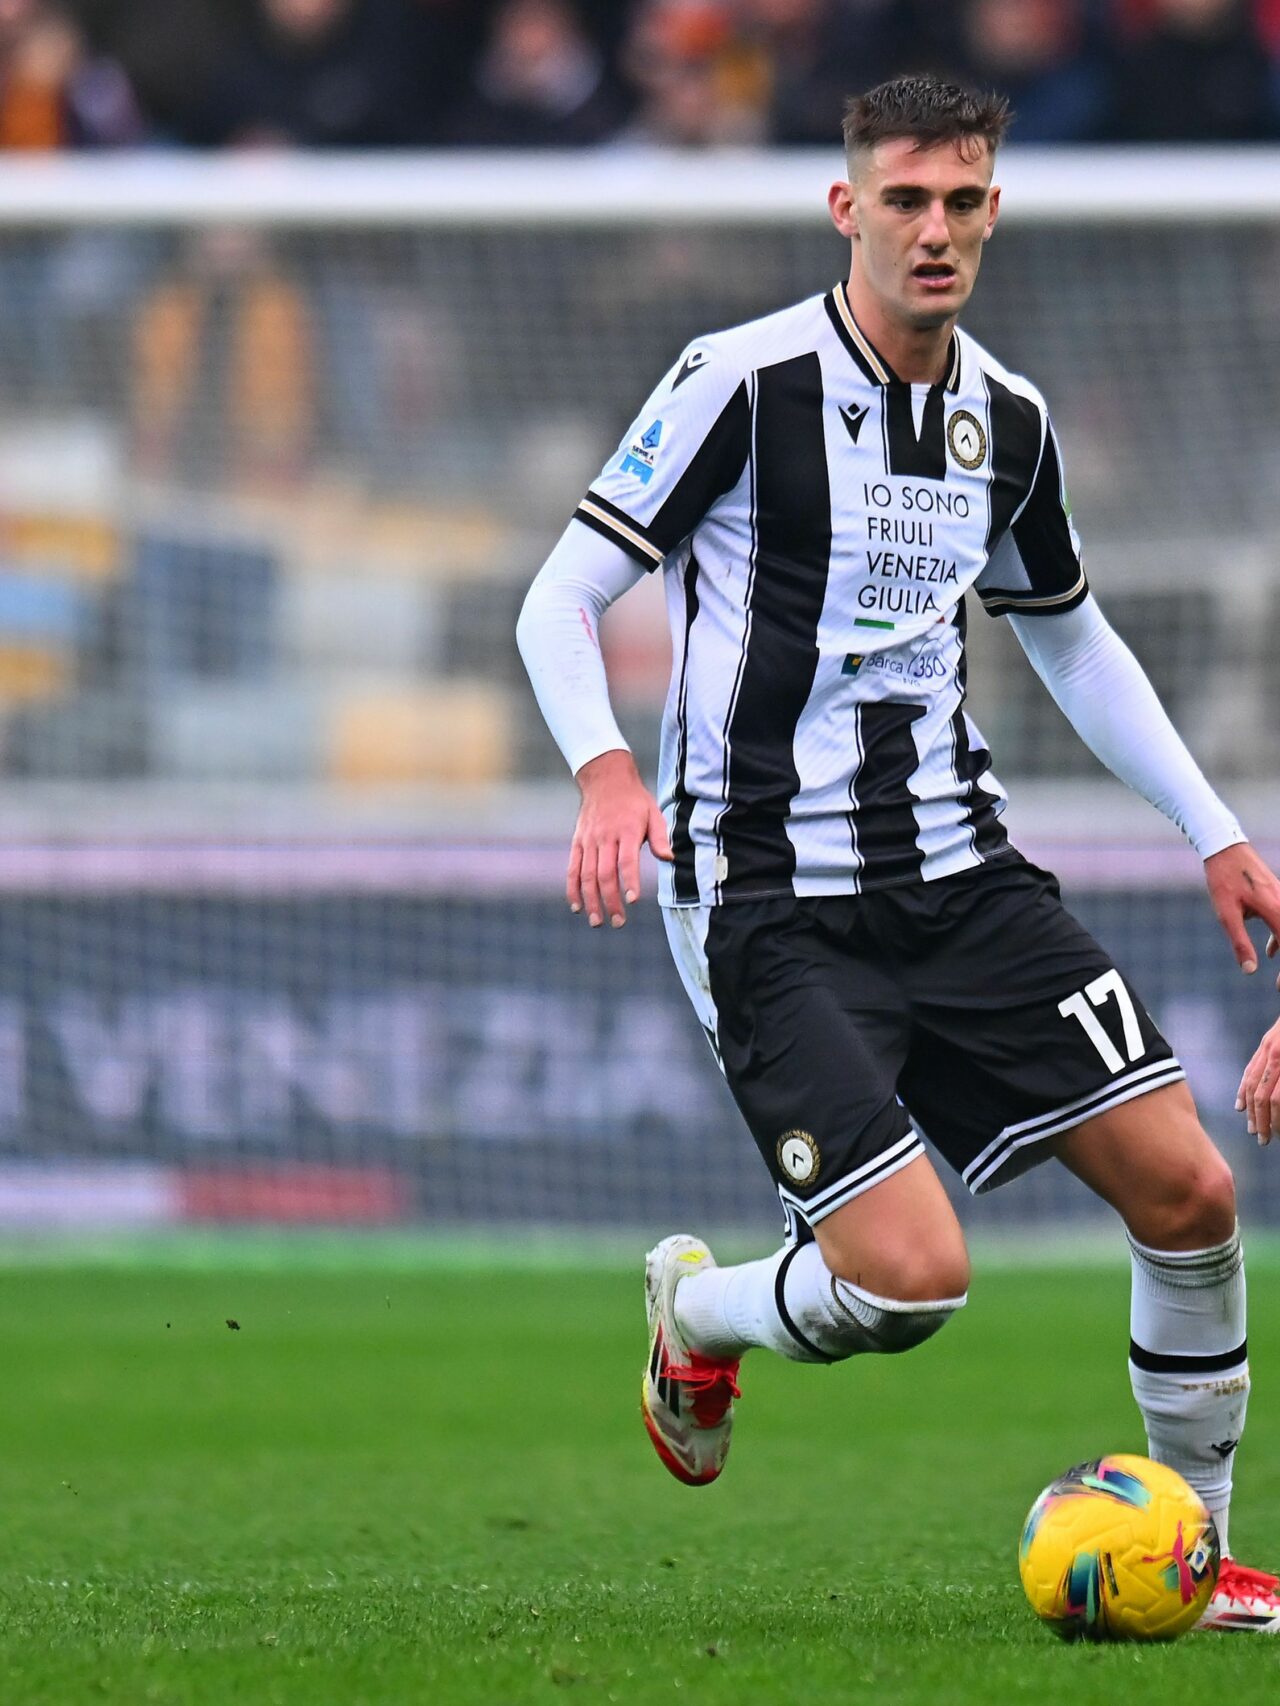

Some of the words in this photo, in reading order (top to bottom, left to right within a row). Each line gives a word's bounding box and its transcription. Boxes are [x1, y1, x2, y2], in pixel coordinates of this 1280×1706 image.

[863, 483, 892, 507] IO
[902, 486, 969, 518] SONO
[867, 516, 933, 547] FRIULI
[866, 551, 959, 585] VENEZIA
[857, 584, 942, 615] GIULIA
[913, 656, 947, 678] 360
[1057, 968, 1146, 1075] 17
